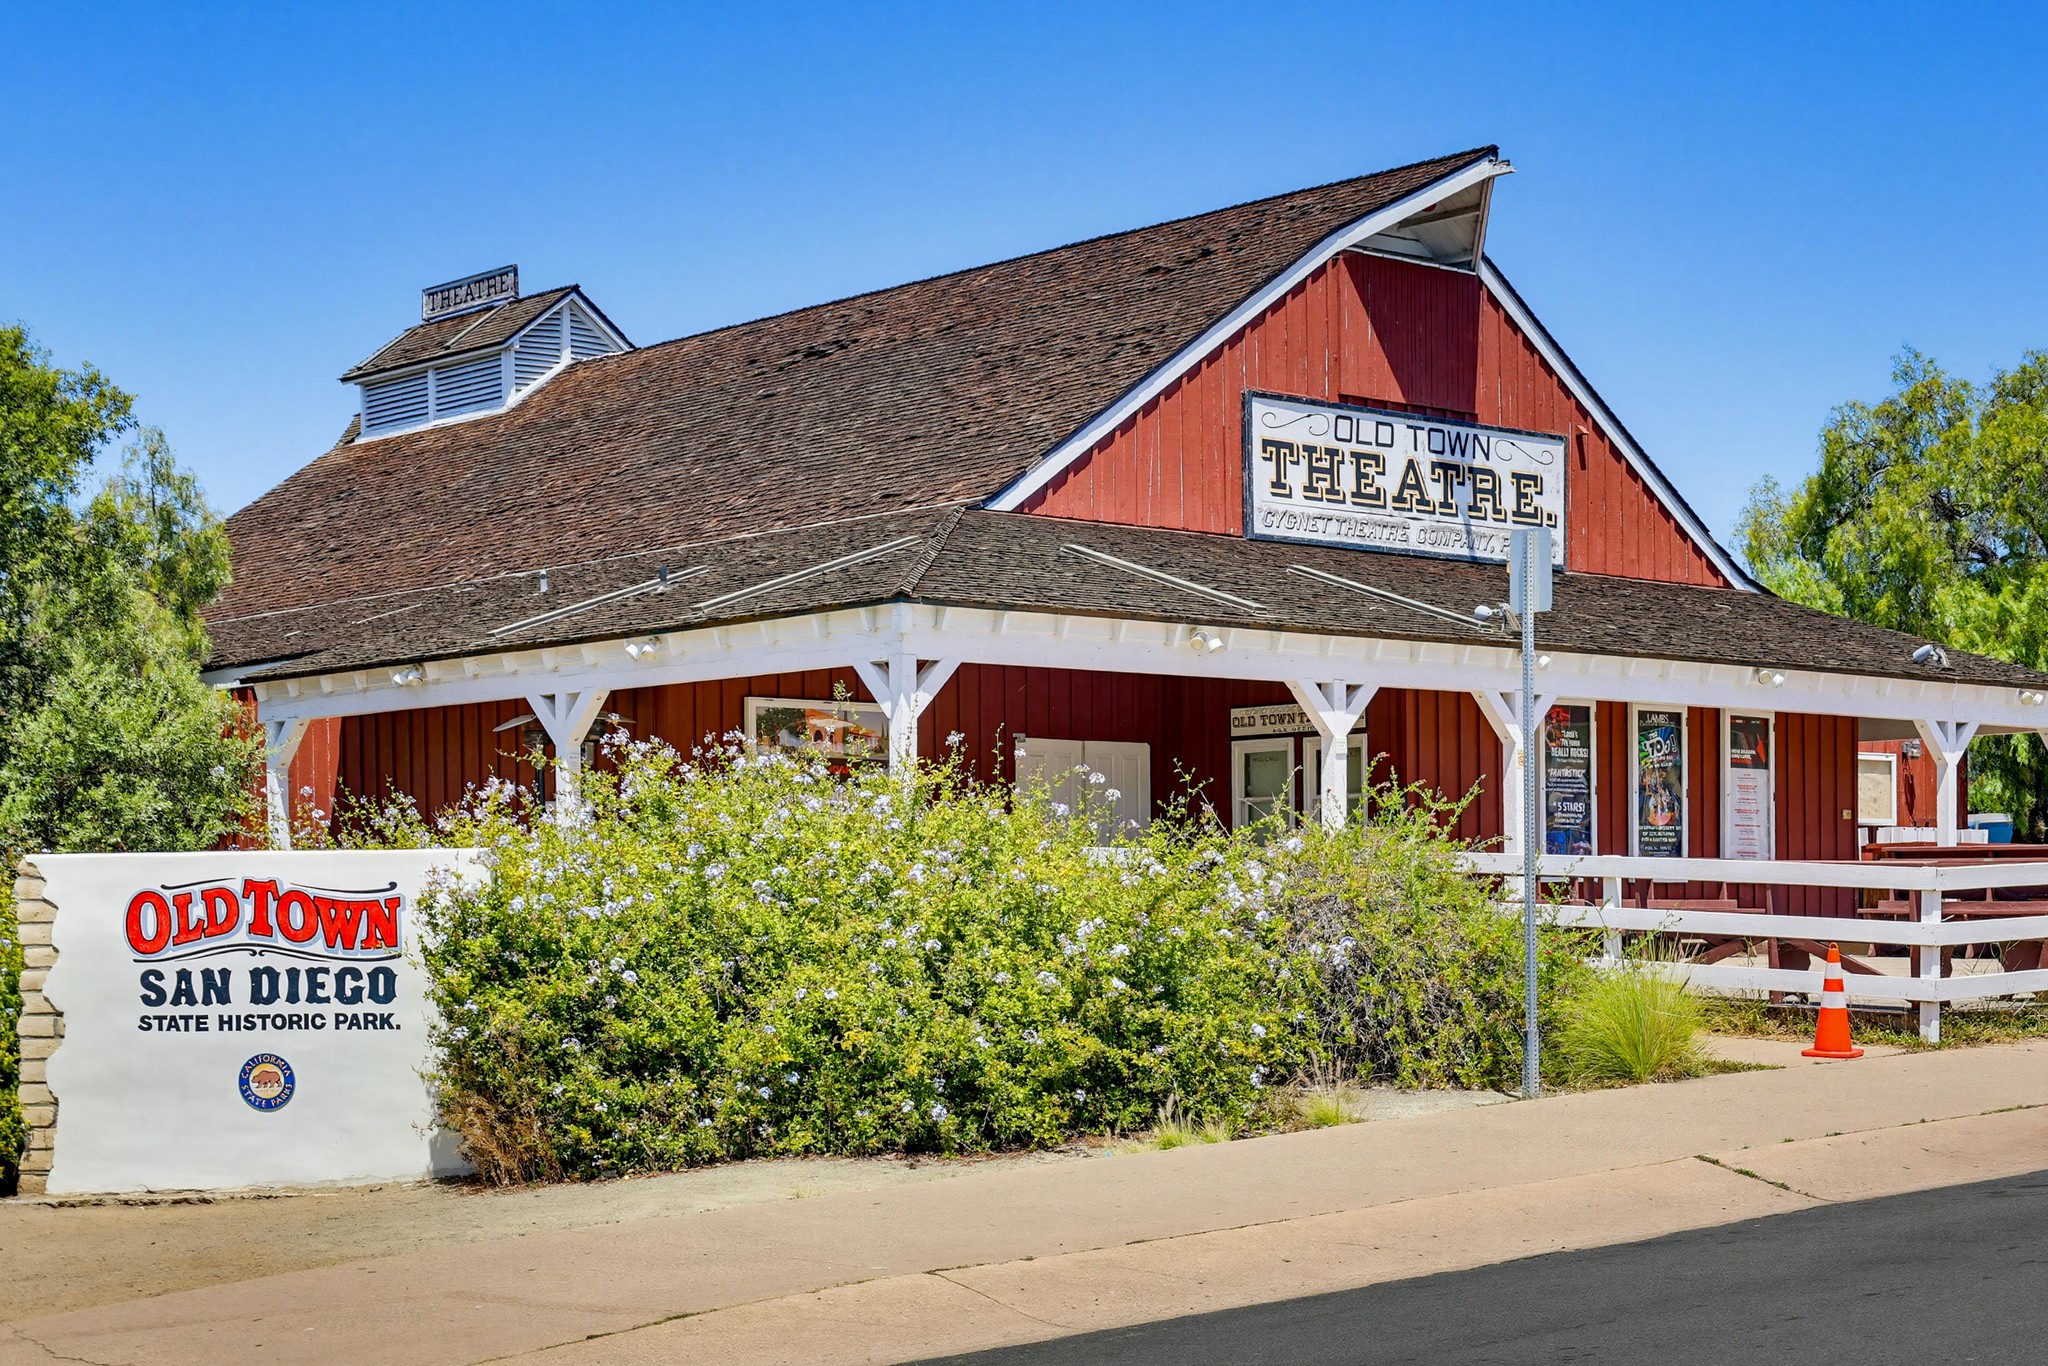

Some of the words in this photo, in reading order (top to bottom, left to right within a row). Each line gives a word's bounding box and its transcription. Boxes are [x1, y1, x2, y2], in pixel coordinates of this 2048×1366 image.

[1334, 415, 1394, 449] OLD
[1406, 425, 1490, 461] TOWN
[1260, 436, 1557, 528] THEATRE.
[1263, 508, 1333, 534] CYGNET
[1335, 517, 1410, 542] THEATRE
[1416, 525, 1495, 554] COMPANY,
[1232, 715, 1256, 728] OLD
[1260, 712, 1296, 727] TOWN
[125, 887, 240, 956] OLD
[242, 878, 402, 951] TOWN
[139, 966, 232, 1007] SAN
[249, 965, 398, 1006] DIEGO
[137, 1014, 210, 1032] STATE
[218, 1012, 327, 1032] HISTORIC
[334, 1012, 401, 1031] PARK.
[241, 1054, 292, 1079] CALIFORNIA
[241, 1084, 267, 1108] STATE
[270, 1083, 293, 1107] PARKS
